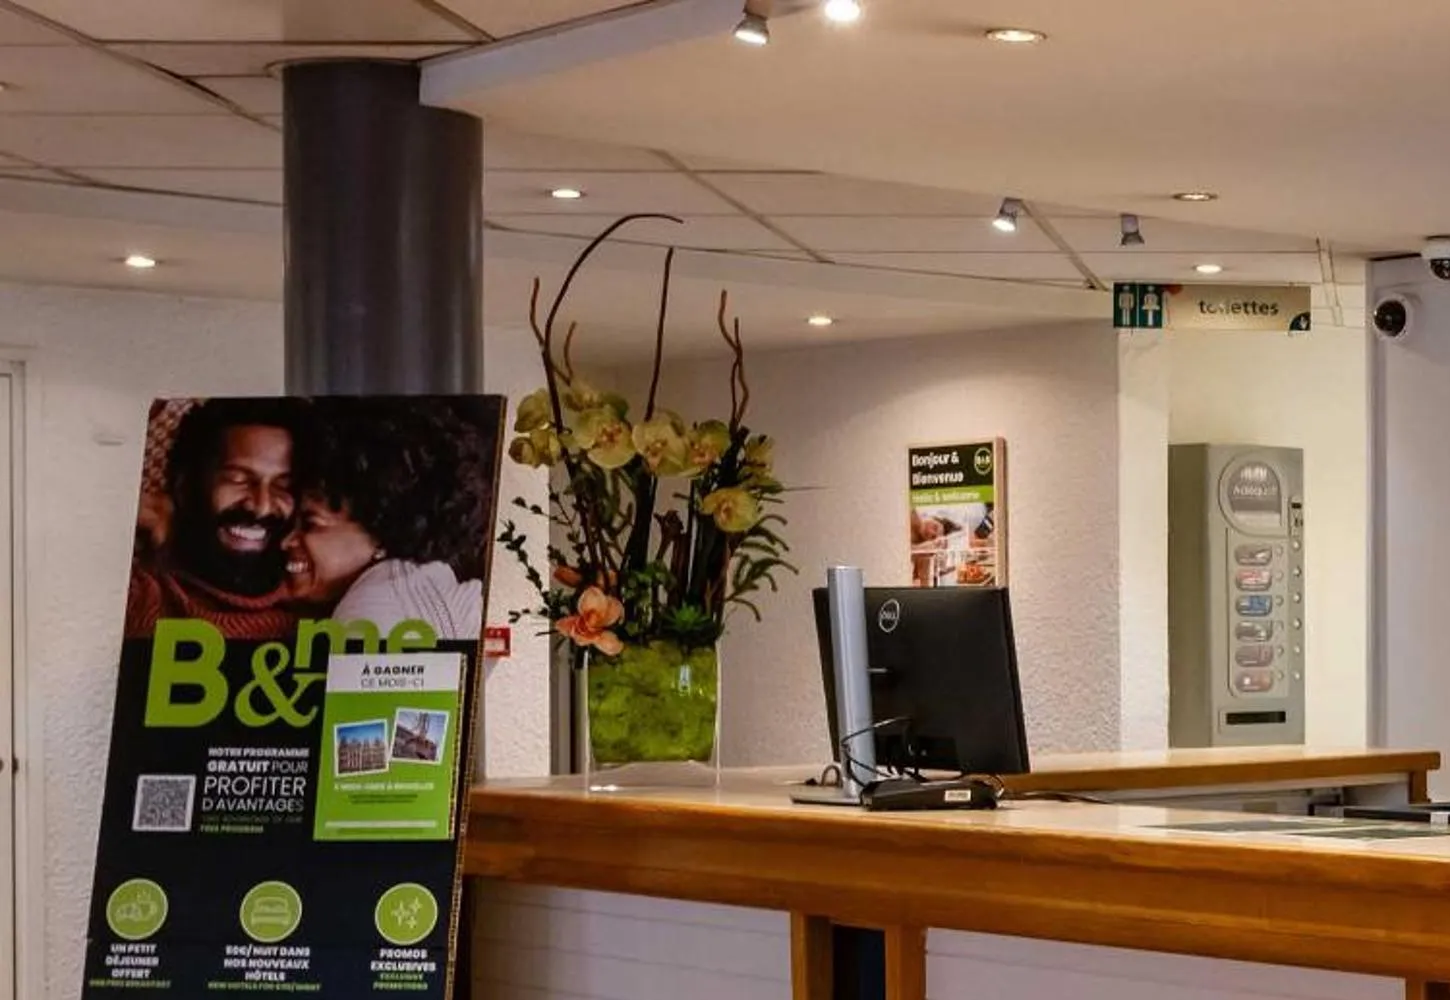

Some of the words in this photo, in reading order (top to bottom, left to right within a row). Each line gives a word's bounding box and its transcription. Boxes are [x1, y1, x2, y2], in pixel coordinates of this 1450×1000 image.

[912, 452, 950, 469] Bonjour
[374, 664, 425, 676] GAGNER
[207, 760, 270, 773] GRATUIT
[272, 760, 308, 774] POUR
[204, 776, 307, 796] PROFITER
